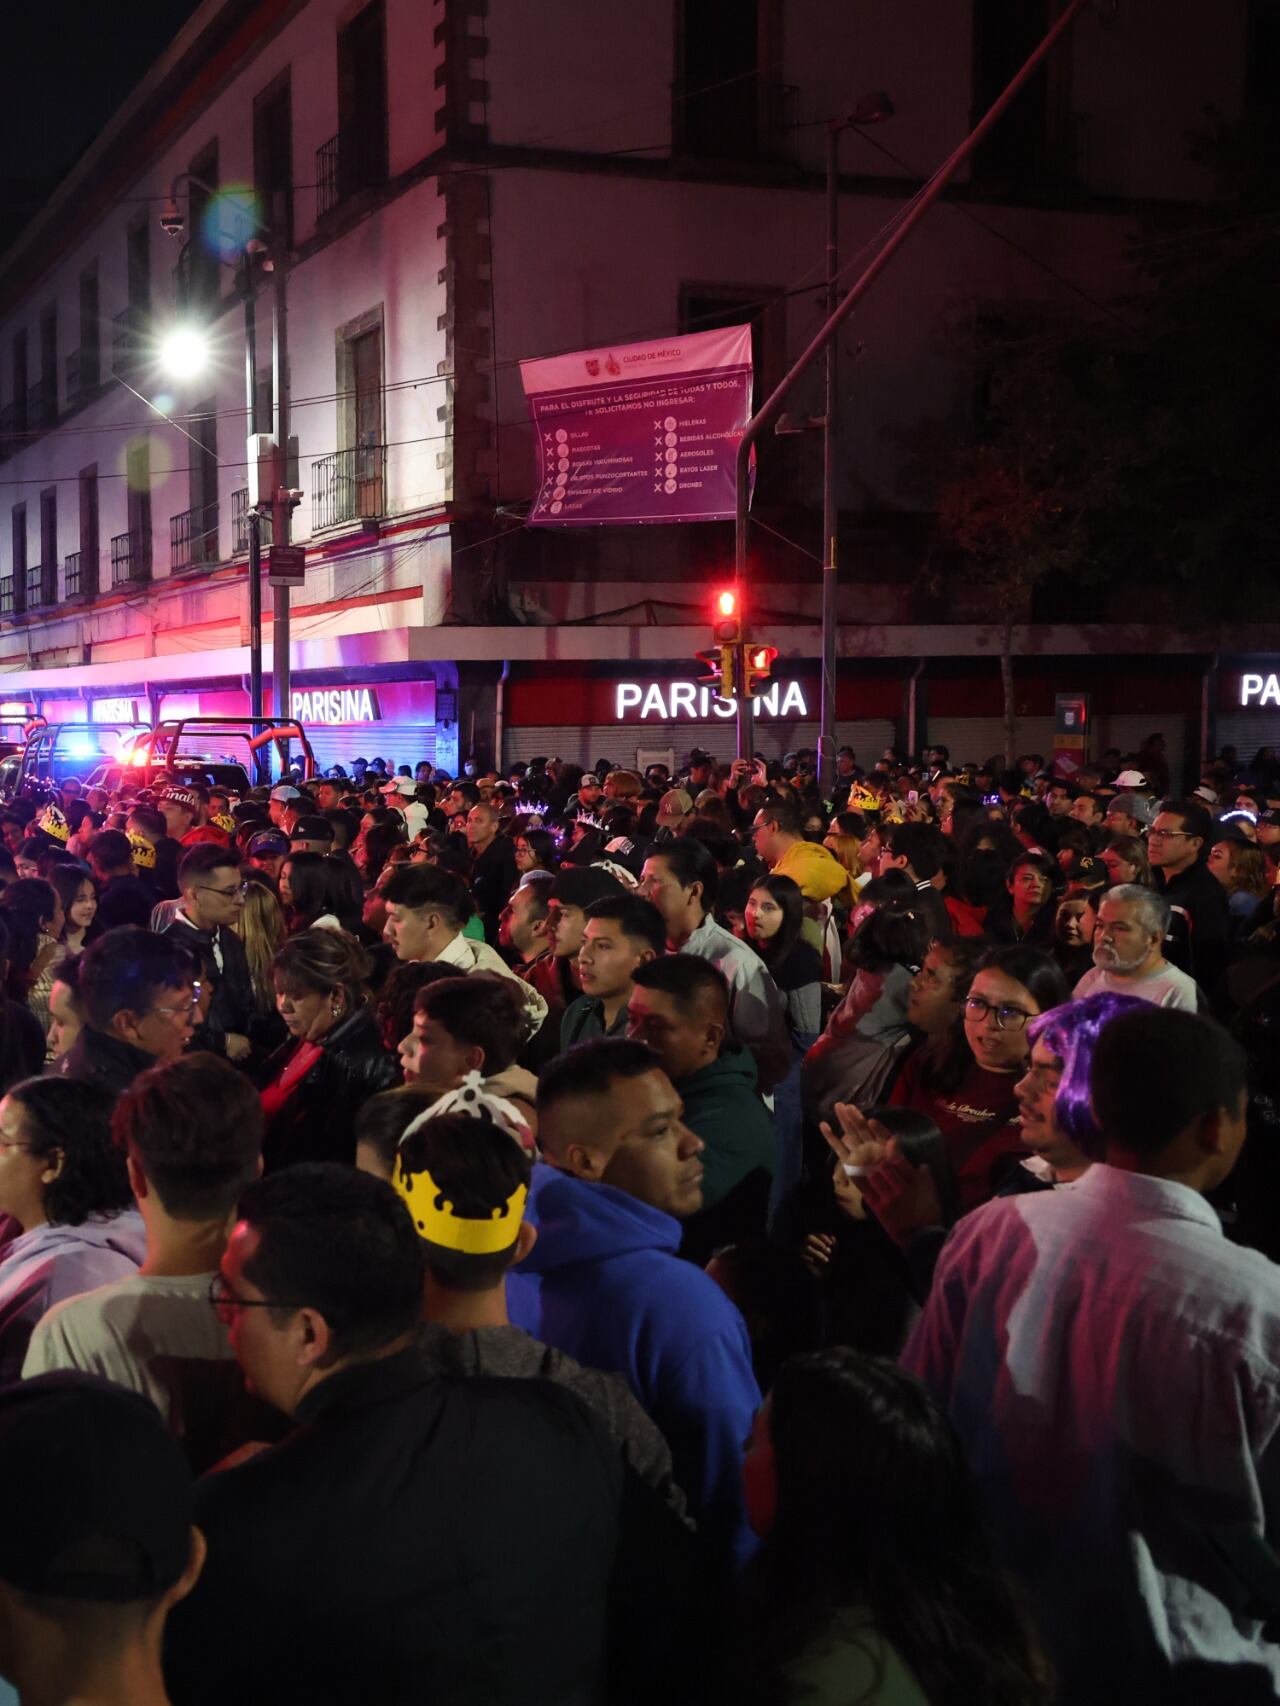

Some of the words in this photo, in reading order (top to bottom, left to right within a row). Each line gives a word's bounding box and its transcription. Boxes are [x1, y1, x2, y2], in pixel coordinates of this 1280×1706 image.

[292, 689, 374, 722] PARISINA
[615, 682, 808, 719] PARISNA
[1241, 674, 1280, 706] PA
